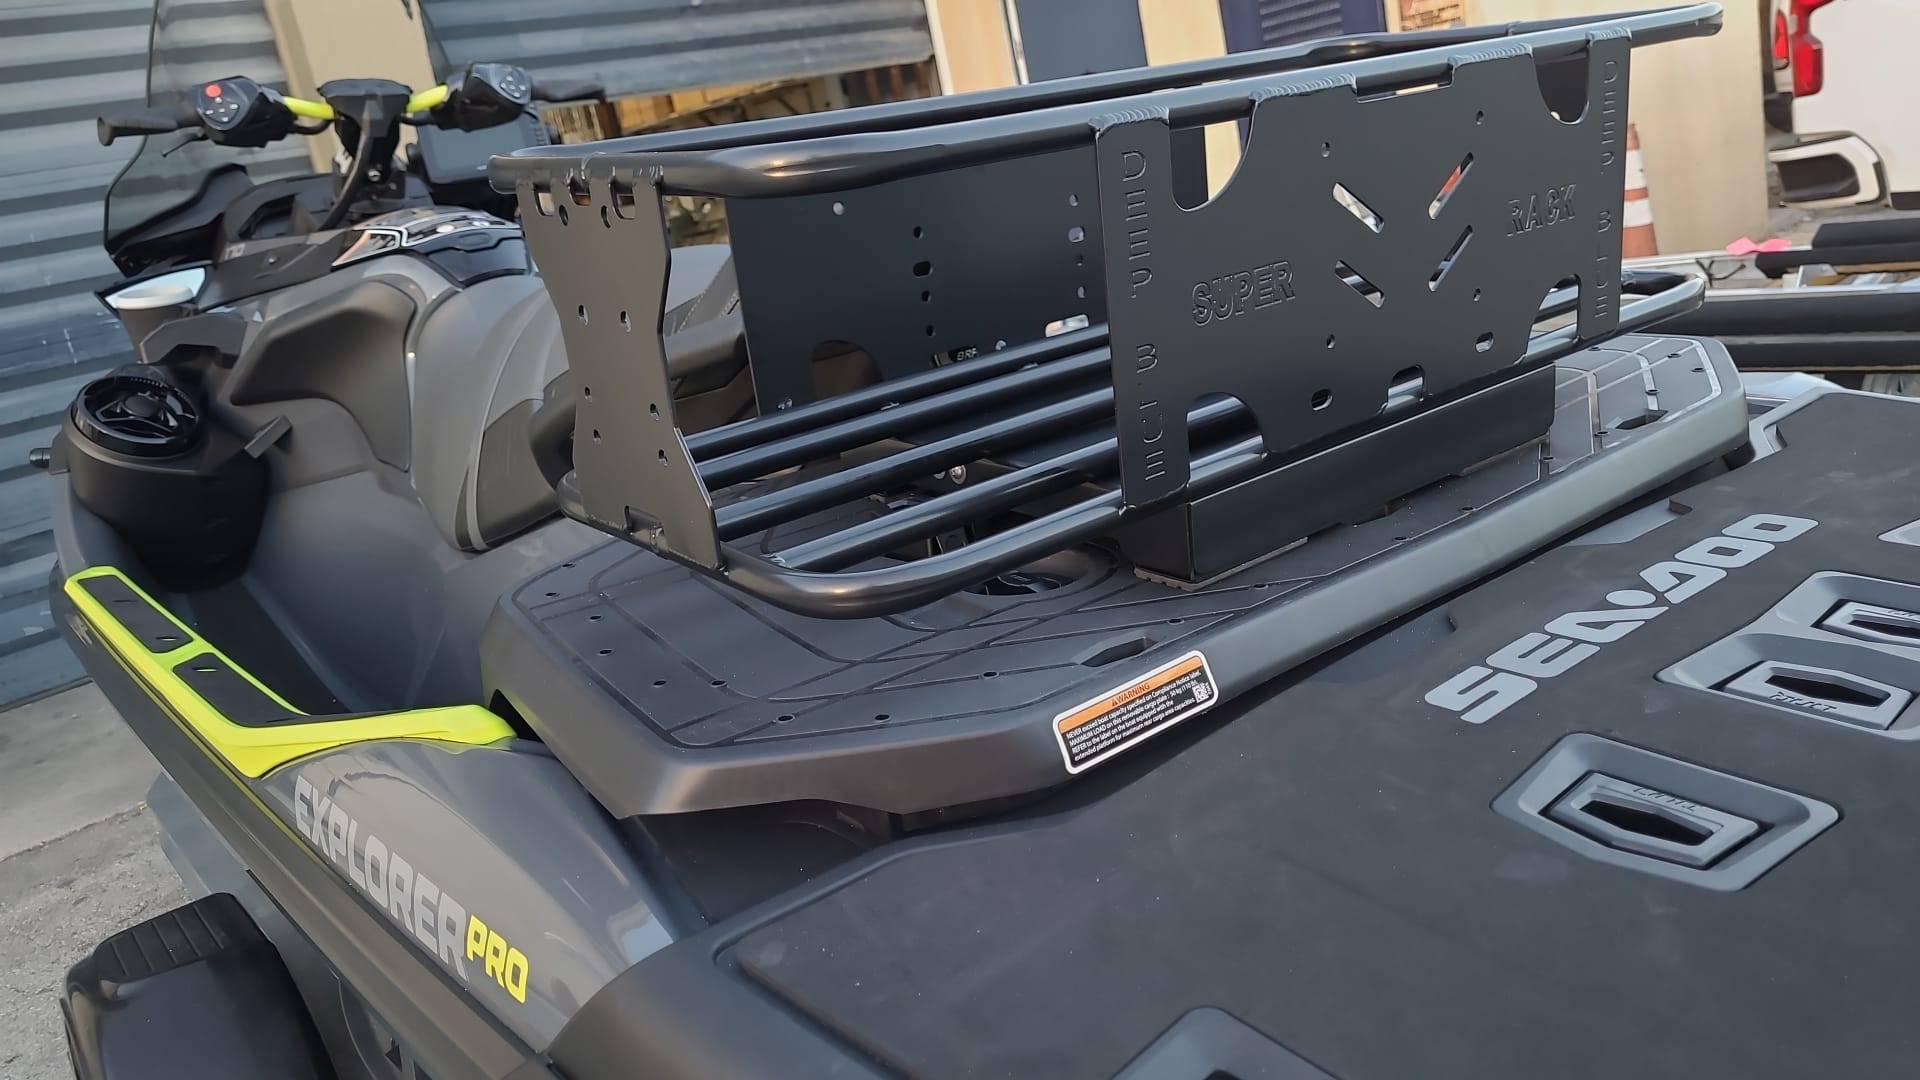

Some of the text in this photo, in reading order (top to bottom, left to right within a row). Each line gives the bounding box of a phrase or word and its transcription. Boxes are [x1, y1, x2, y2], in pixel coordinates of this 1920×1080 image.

[1121, 149, 1152, 299] DEEP
[1192, 183, 1577, 326] SUPER RACK
[1066, 728, 1082, 740] NEVER
[1081, 720, 1098, 732] exceed
[1096, 715, 1109, 725] boat
[1108, 707, 1127, 721] capacity
[1126, 698, 1146, 711] specified
[1151, 683, 1176, 699] Compliance
[1175, 676, 1190, 686] Notice
[1117, 683, 1150, 703] WARNING
[1069, 731, 1093, 746] MAXIMUM
[1092, 724, 1106, 735] LOAD
[1112, 717, 1121, 725] this
[1121, 707, 1144, 721] removable
[1143, 702, 1156, 712] cargo
[1071, 744, 1086, 754] REFER
[1091, 736, 1100, 744] the
[1099, 730, 1111, 740] label
[1116, 723, 1125, 732] the
[1124, 718, 1136, 728] boat
[1135, 709, 1157, 723] equipped
[1156, 703, 1166, 712] with
[1165, 699, 1174, 707] the
[1074, 746, 1096, 761] extended
[1095, 738, 1115, 751] platform
[1114, 733, 1122, 741] for
[1122, 725, 1144, 737] maximum
[1152, 714, 1165, 723] cargo
[295, 776, 529, 1004] EXPLORER PRO
